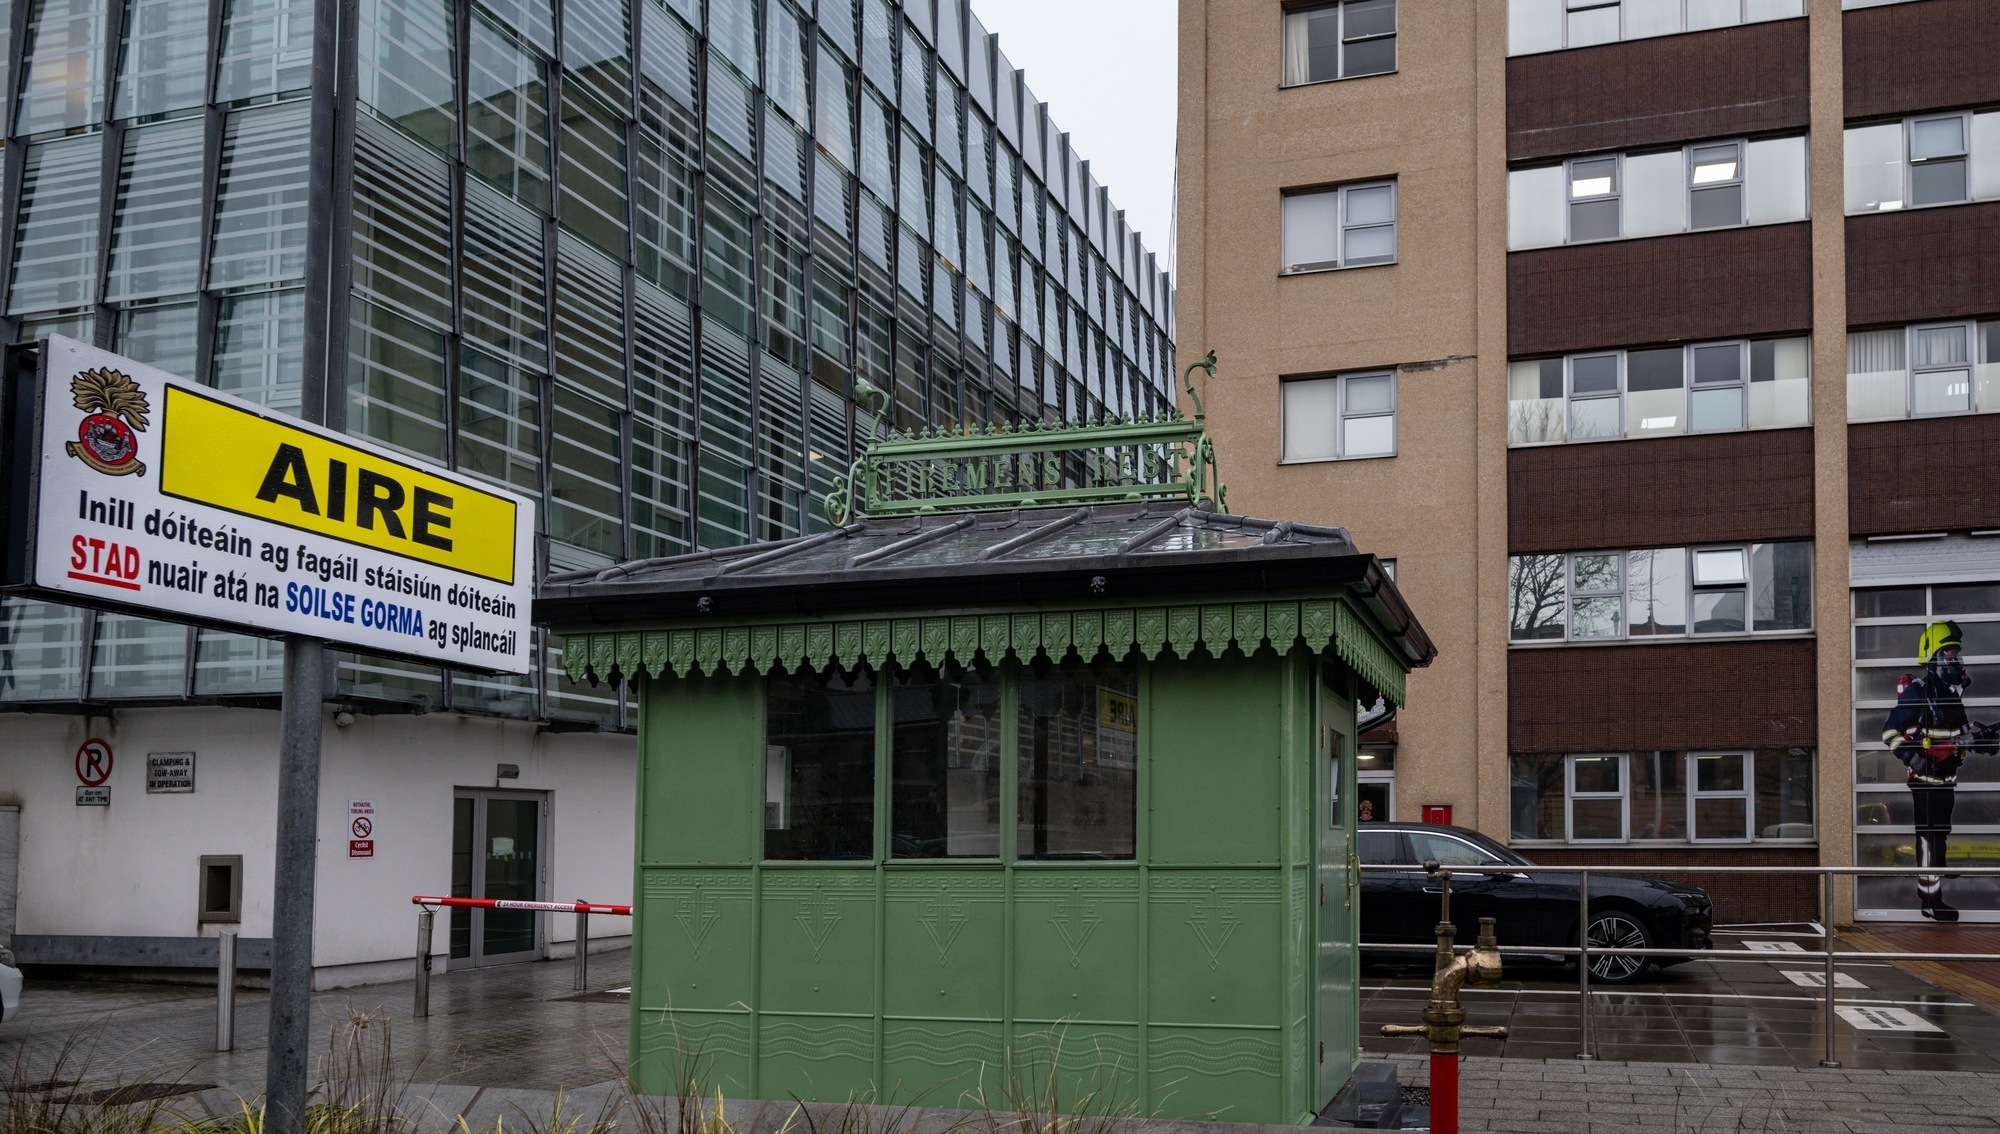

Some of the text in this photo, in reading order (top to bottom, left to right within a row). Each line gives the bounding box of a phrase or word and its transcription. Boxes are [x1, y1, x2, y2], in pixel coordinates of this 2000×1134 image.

[1093, 447, 1188, 482] REST
[256, 442, 454, 552] AIRE
[79, 489, 516, 620] Inill dóiteáin ag fagáil stáisiún dóiteáin
[70, 534, 516, 656] STAD nuair atá na SOILSE GORMA ag splancáil
[152, 758, 183, 767] CLAMPING
[154, 769, 188, 777] TOW-AWAY
[150, 780, 191, 788] IN OPERATION
